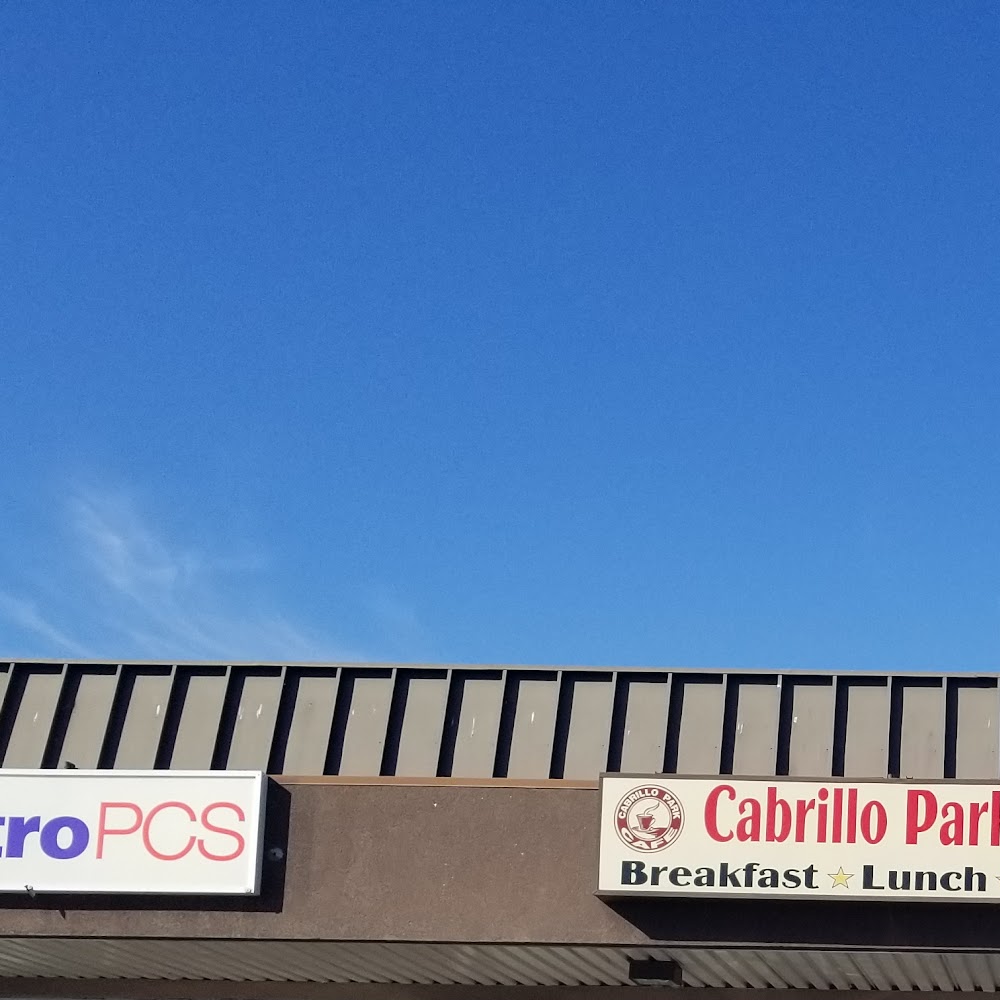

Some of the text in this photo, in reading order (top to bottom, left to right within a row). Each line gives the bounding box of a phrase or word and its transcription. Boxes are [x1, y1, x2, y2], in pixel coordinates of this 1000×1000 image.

[619, 788, 681, 820] CABRILLO PARK
[704, 784, 888, 844] Cabrillo
[0, 802, 246, 861] roPCS
[621, 827, 678, 849] CAFE
[620, 860, 820, 889] Breakfast
[862, 864, 987, 892] Lunch
